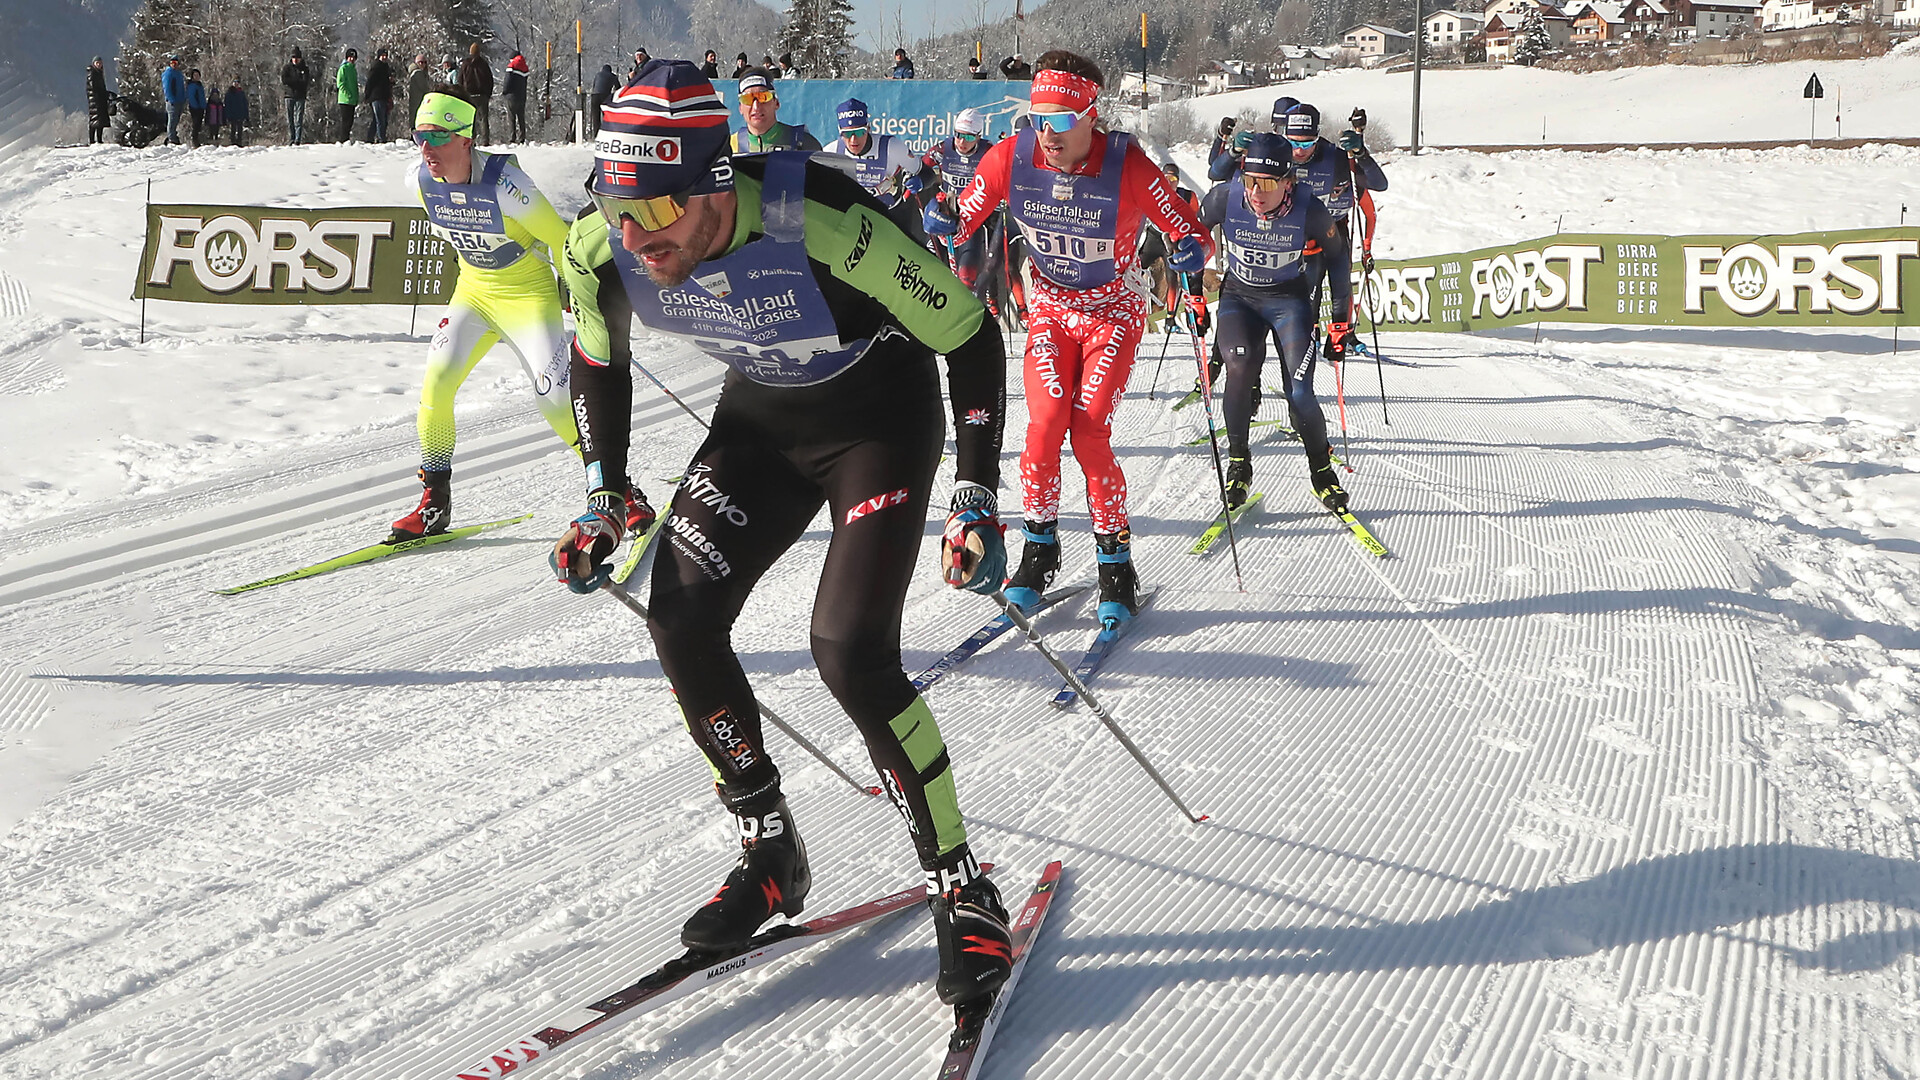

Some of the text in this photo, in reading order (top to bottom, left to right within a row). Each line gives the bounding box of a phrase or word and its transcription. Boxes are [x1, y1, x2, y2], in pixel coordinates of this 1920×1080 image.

[434, 204, 491, 218] GsieserTalLauf
[1023, 200, 1102, 220] GsieserTalLauf
[1148, 177, 1194, 235] Interno
[409, 219, 434, 235] BIR
[407, 236, 446, 256] BIÈRE
[449, 231, 491, 251] 554
[1036, 231, 1086, 259] 510
[147, 214, 394, 293] FORST
[1243, 250, 1279, 268] 531
[1617, 244, 1657, 259] BIRRA
[405, 260, 443, 274] BEER
[762, 269, 803, 277] Raiffeisen
[1442, 262, 1462, 275] BIRRA
[1617, 259, 1658, 277] BIÈRE
[404, 279, 441, 294] BIER
[893, 254, 948, 310] TRENTINO
[1471, 245, 1604, 319] FORST
[1682, 239, 1919, 315] FORST
[1617, 281, 1658, 296] BEER
[1443, 293, 1463, 306] BEER
[1617, 299, 1658, 314] BIER
[1442, 309, 1462, 322] BIER
[691, 322, 778, 342] 41th edition 2025
[1032, 329, 1064, 399] TRENTINO
[1074, 324, 1127, 411] Internorm
[392, 537, 427, 552] FISCHER
[708, 709, 758, 770] Lab4Ski
[706, 957, 747, 980] MADSHUS
